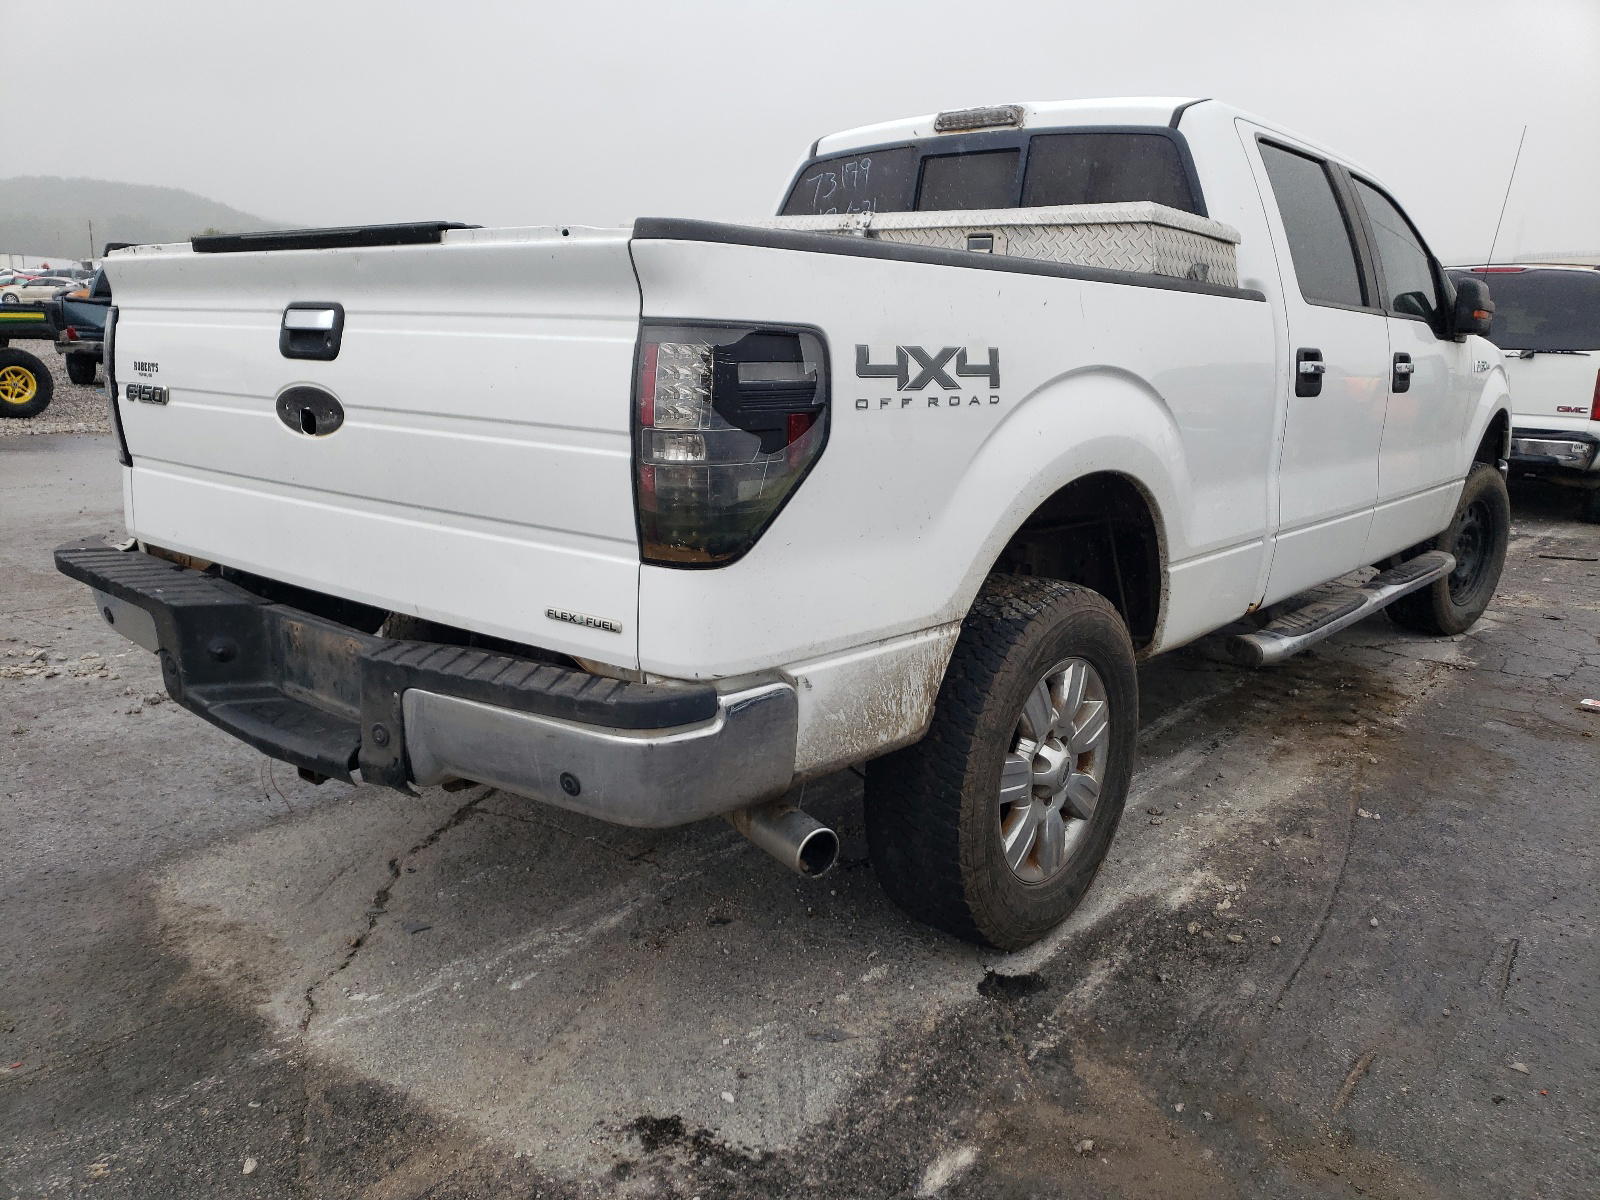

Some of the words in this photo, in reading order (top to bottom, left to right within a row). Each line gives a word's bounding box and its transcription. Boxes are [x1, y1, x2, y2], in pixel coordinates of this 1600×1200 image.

[133, 360, 159, 373] ROBERTS
[855, 397, 913, 410] OFF
[927, 394, 1000, 408] ROAD
[1556, 405, 1589, 414] GMC
[546, 608, 577, 623] FLEX
[585, 616, 617, 632] FUEL
